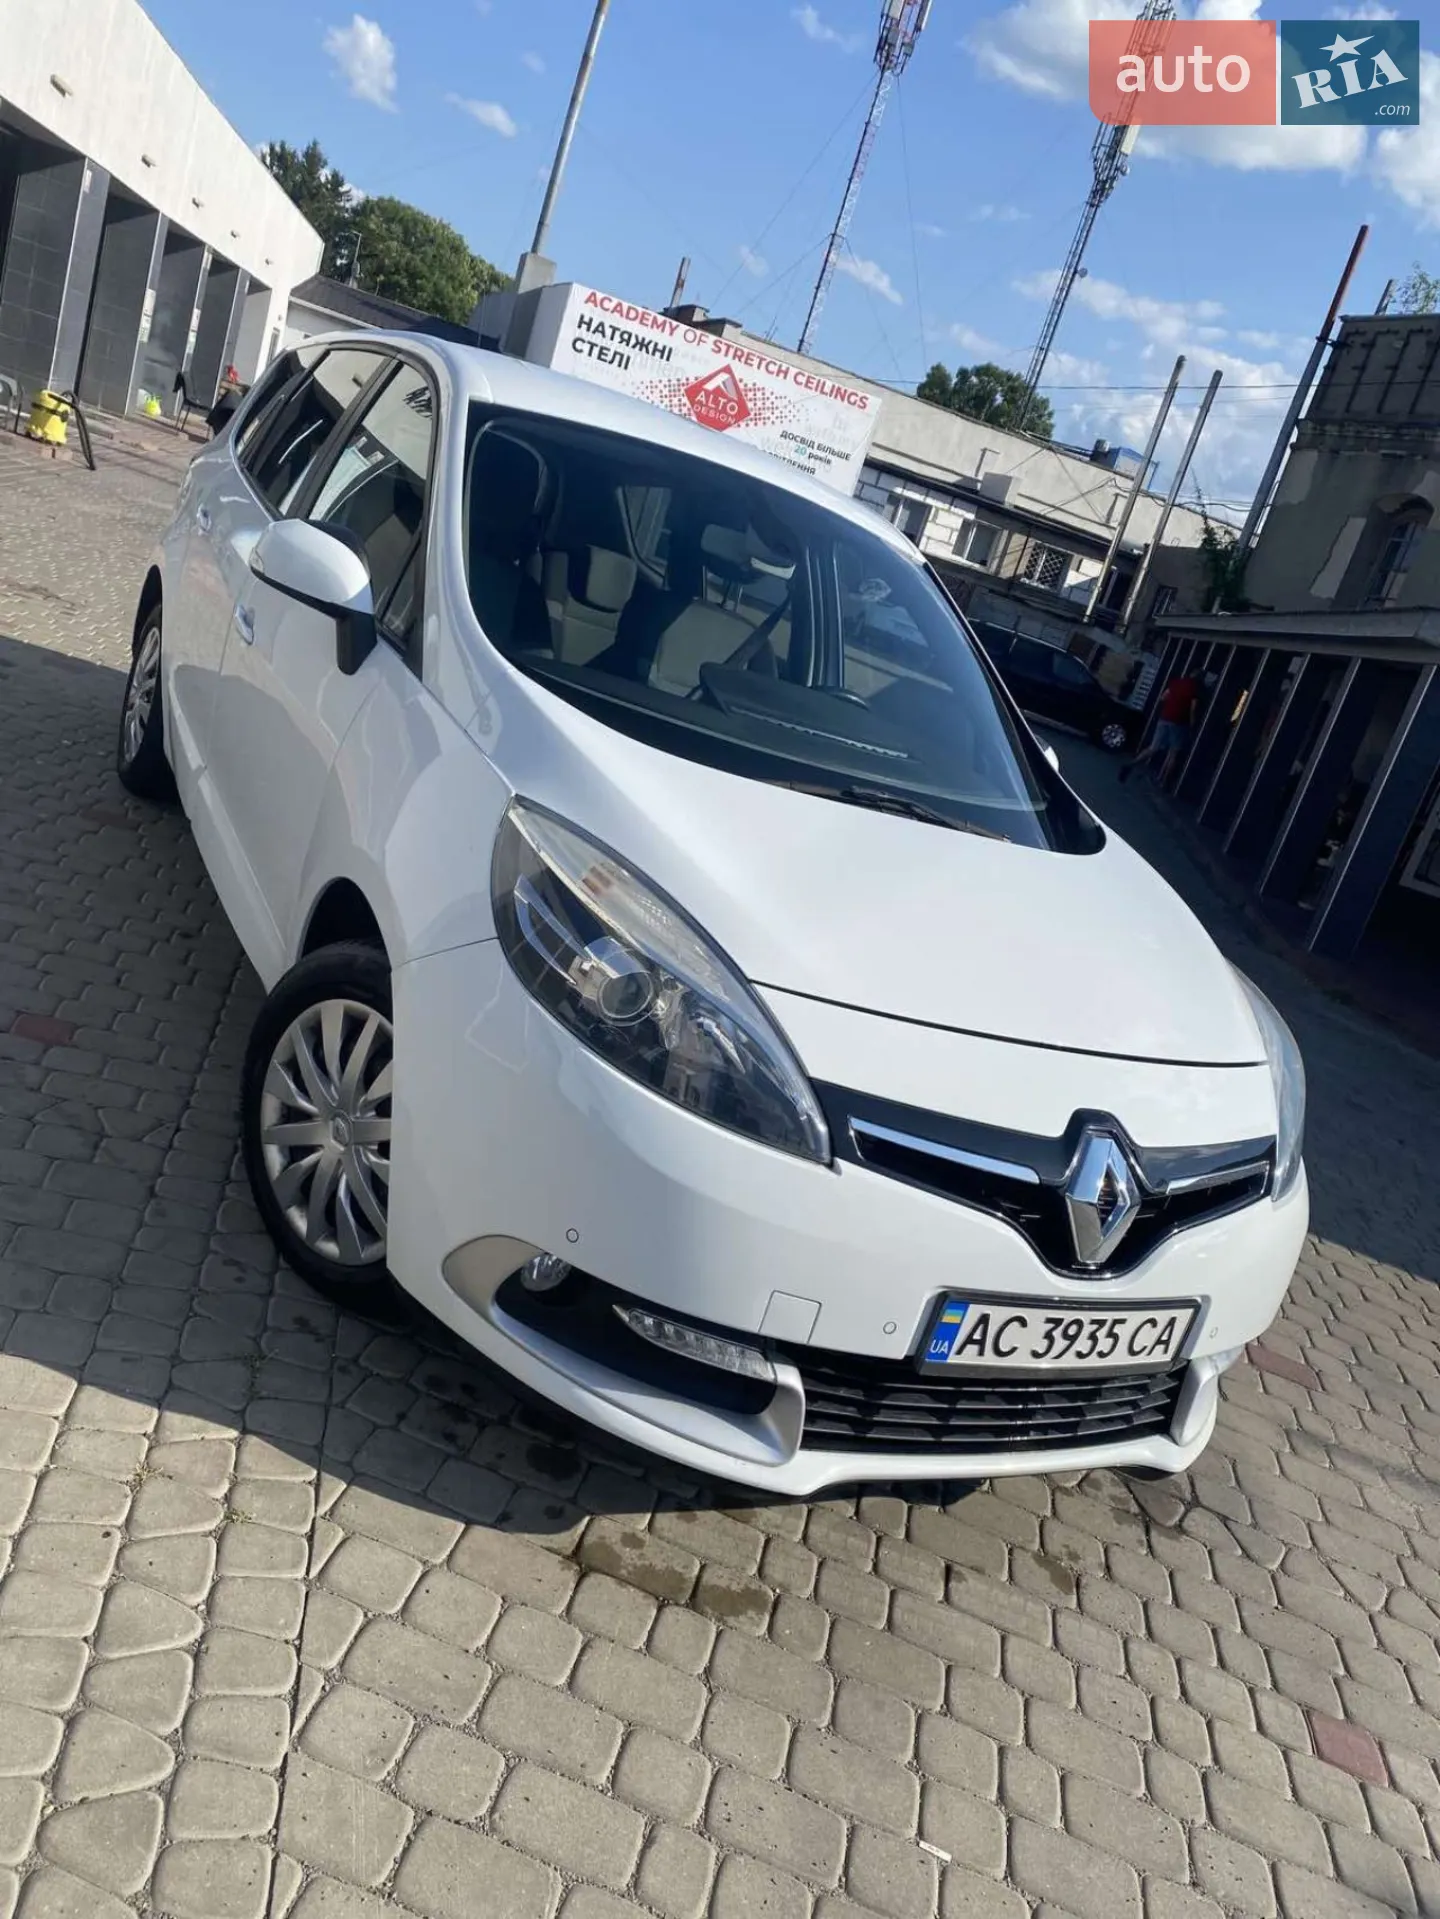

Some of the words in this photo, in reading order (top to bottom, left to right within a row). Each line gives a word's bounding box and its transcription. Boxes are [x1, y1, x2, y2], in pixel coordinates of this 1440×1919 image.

[577, 314, 673, 362] НАТЯЖНІ
[584, 291, 680, 337] ACADEMY
[683, 328, 709, 346] OF
[711, 339, 790, 380] STRETCH
[793, 371, 869, 410] CEILINGS
[572, 337, 631, 371] СТЕЛІ
[693, 404, 736, 425] DESIGN
[695, 390, 738, 415] ALTO
[780, 430, 815, 449] ДОСВІД
[816, 442, 852, 461] БІЛЬШЕ
[794, 444, 807, 456] 20
[930, 1340, 948, 1354] UA
[954, 1313, 1028, 1358] AC
[1030, 1317, 1127, 1360] 3935
[1127, 1316, 1178, 1358] CA
